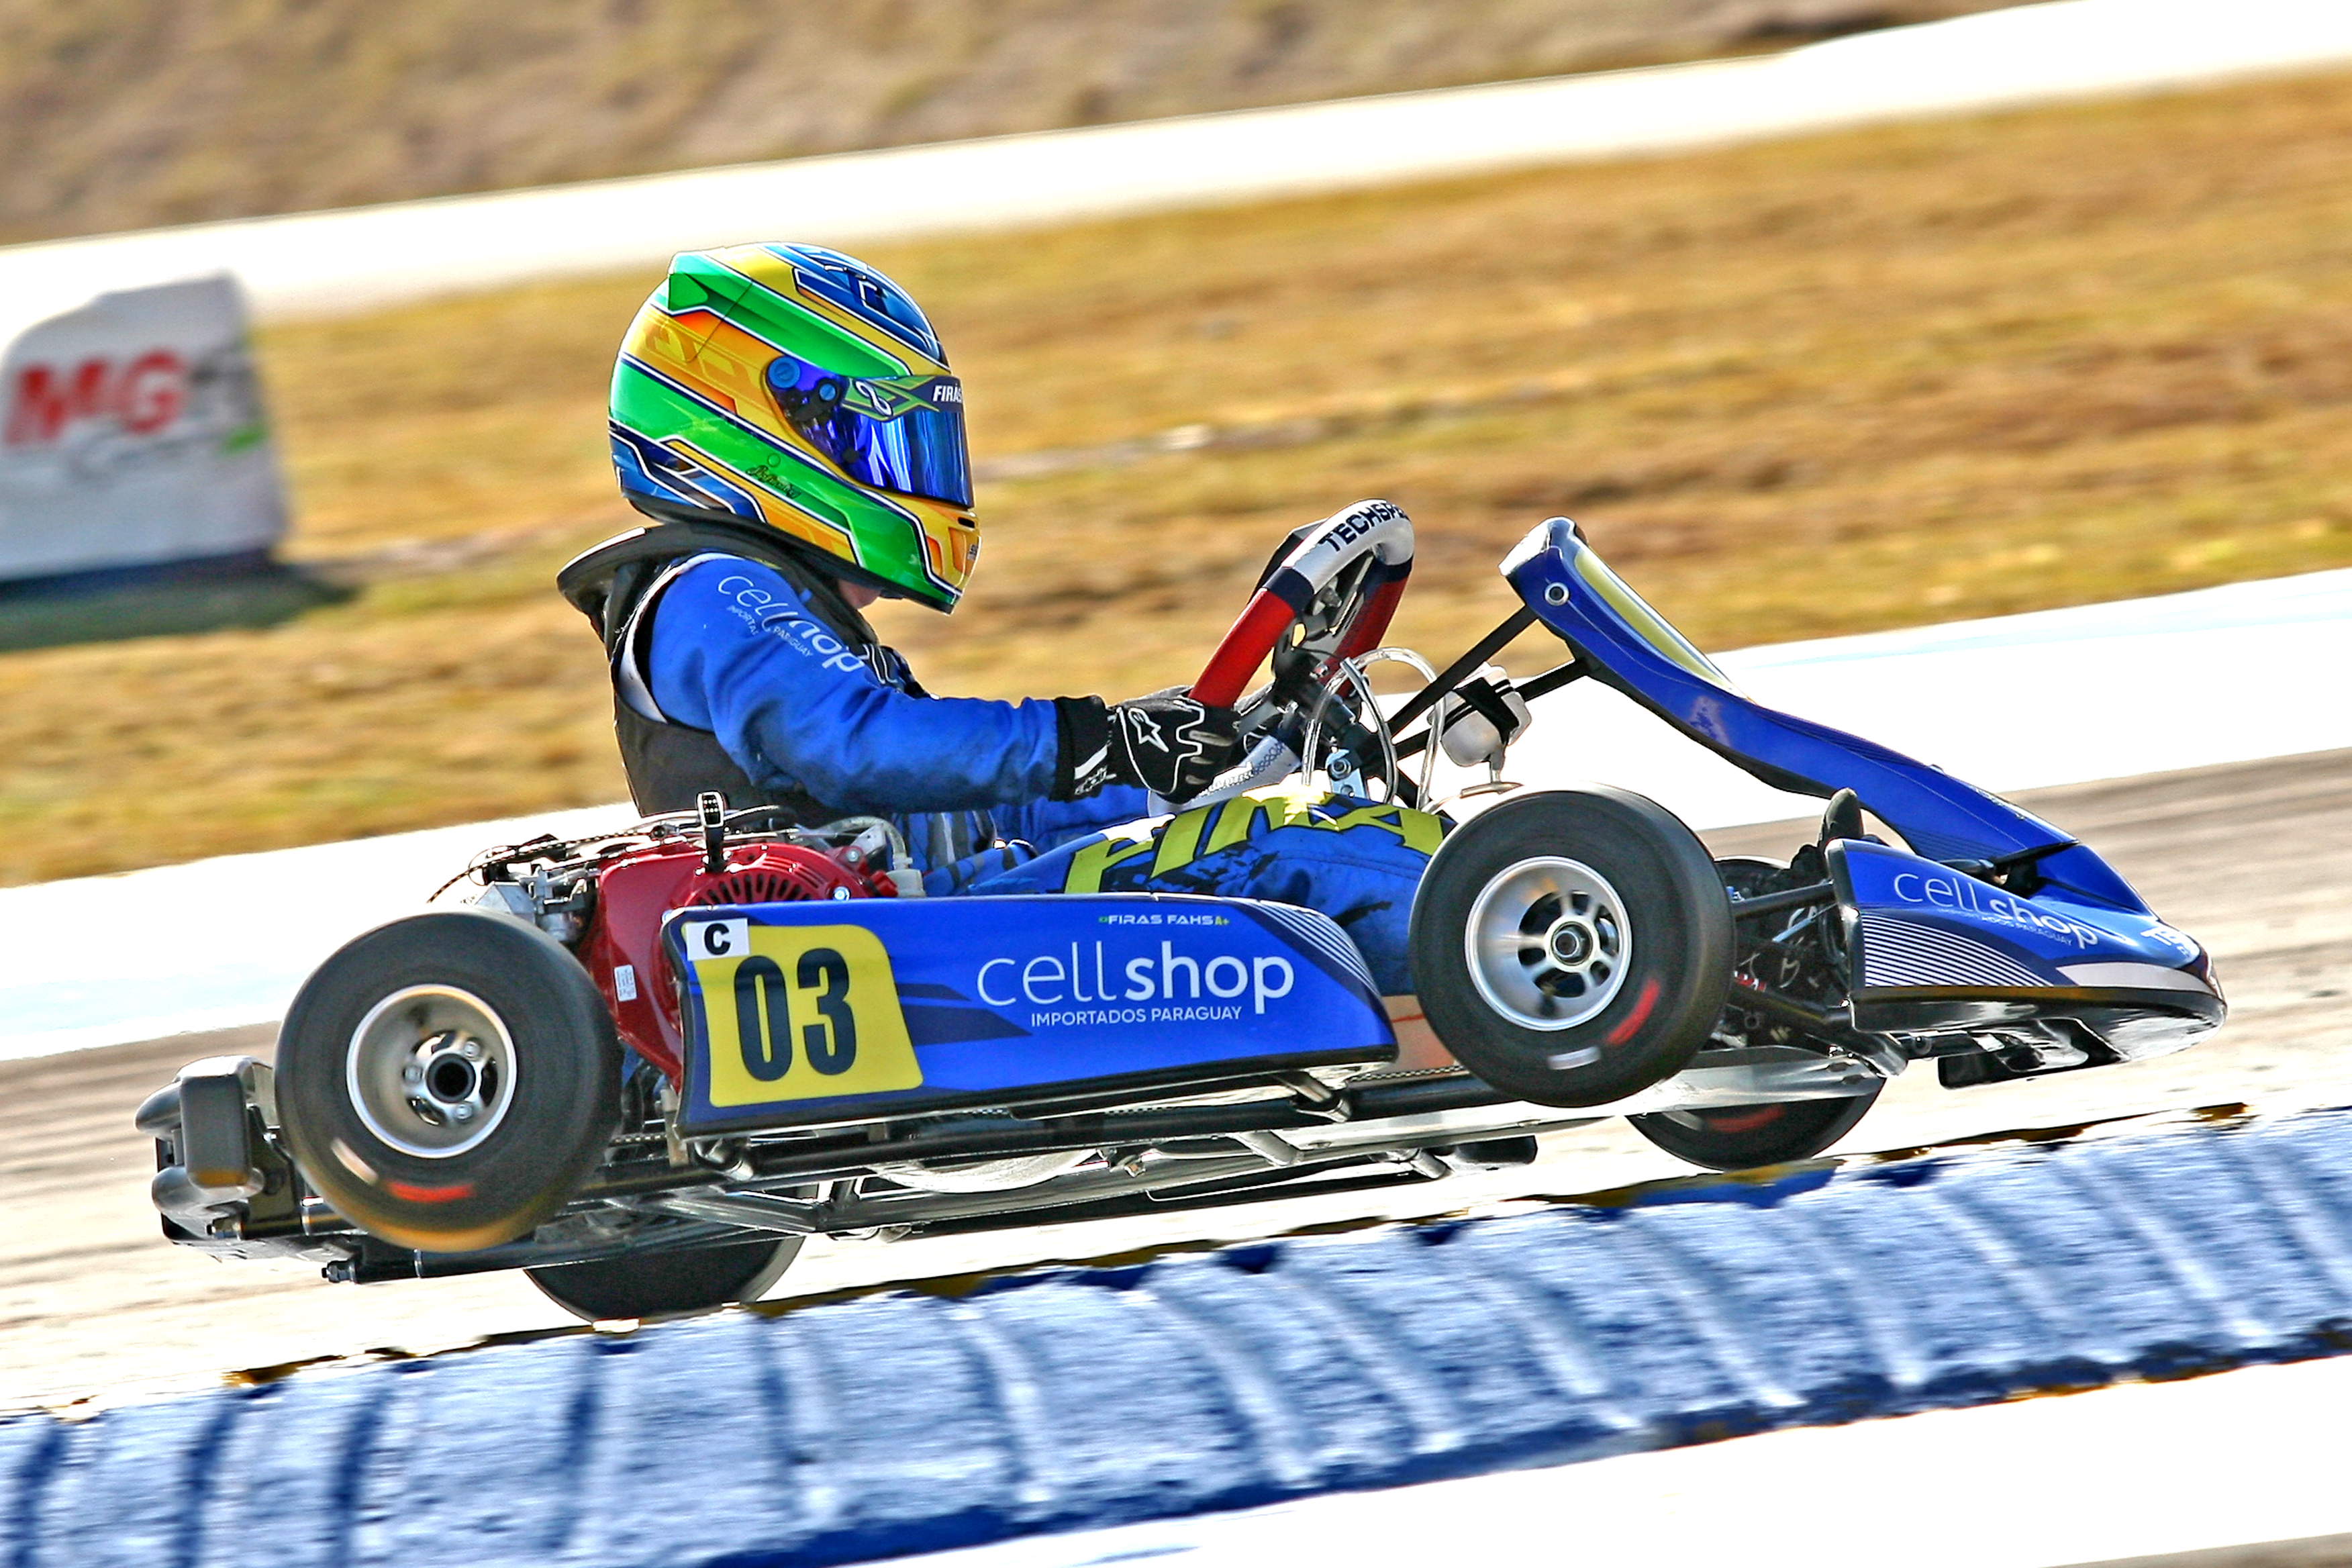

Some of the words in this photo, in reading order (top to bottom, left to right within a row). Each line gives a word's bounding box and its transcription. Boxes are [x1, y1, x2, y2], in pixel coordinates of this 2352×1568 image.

[1108, 914, 1163, 925] FIRAS
[703, 923, 731, 956] C
[734, 947, 857, 1083] 03
[1031, 1008, 1146, 1027] IMPORTADOS
[1151, 1006, 1242, 1023] PARAGUAY
